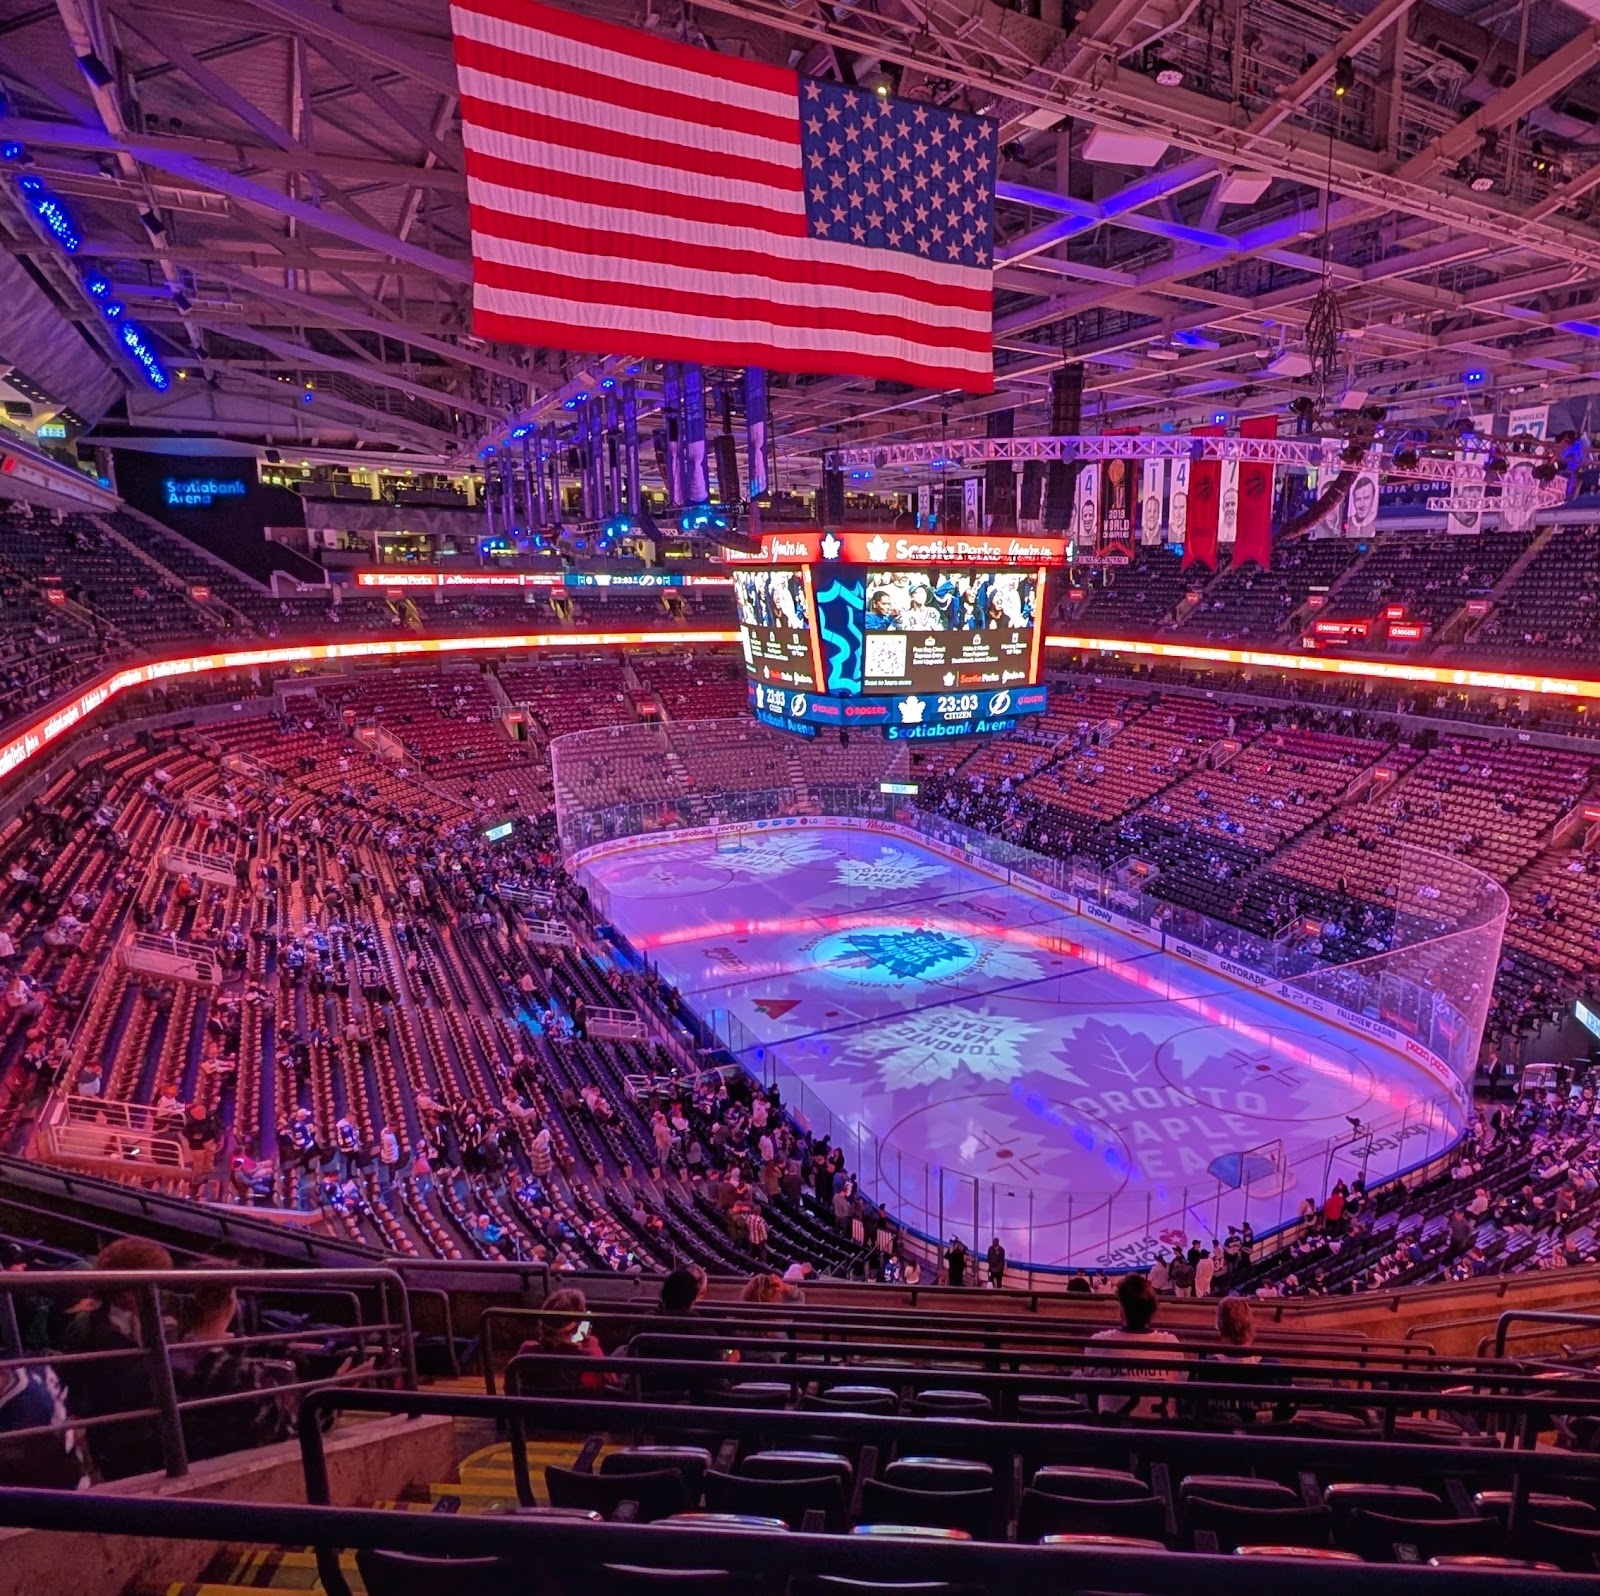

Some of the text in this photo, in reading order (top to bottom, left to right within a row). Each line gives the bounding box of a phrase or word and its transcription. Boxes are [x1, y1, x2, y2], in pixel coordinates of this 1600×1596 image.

[1176, 463, 1186, 488] 4
[167, 481, 246, 494] Scotiabank
[1085, 474, 1093, 496] 4
[1379, 481, 1449, 495] EDIA GOND
[168, 493, 212, 504] Arena
[967, 487, 976, 506] 21
[1108, 509, 1126, 519] 2019
[1103, 519, 1130, 531] WORLD
[895, 538, 955, 561] Scotia
[956, 541, 1001, 562] Perks
[960, 673, 981, 684] Scotia
[766, 688, 786, 707] 23:03
[937, 694, 979, 712] 23:03
[854, 706, 887, 716] ROGERS
[943, 711, 972, 720] CITIZEN
[787, 719, 816, 736] Arena
[888, 718, 1016, 740] Scotiabank Arena
[892, 785, 907, 793] IBM
[673, 828, 713, 839] Scotiabank
[865, 819, 897, 832] Molson
[905, 827, 923, 840] ROGERS
[853, 867, 925, 880] TORONTO
[853, 876, 907, 885] LEAFS
[859, 871, 911, 881] MAPLE
[1087, 905, 1113, 923] chewy
[1220, 961, 1266, 987] GATORADE
[848, 980, 905, 990] Arena
[1292, 991, 1324, 1011] PS5
[931, 1015, 1005, 1037] LEAFS
[1337, 1008, 1372, 1029] FALLSVIEW
[1373, 1023, 1397, 1040] CASINO
[895, 1026, 1001, 1057] TORONTO
[921, 1023, 994, 1046] MAPLE
[1406, 1040, 1449, 1079] pizza pizza
[1051, 1086, 1268, 1127] TORONTO
[1090, 1113, 1261, 1147] MAPLE
[1350, 1122, 1435, 1158] Uber Eats
[1096, 1235, 1159, 1266] STARS
[1115, 1245, 1172, 1268] POK
